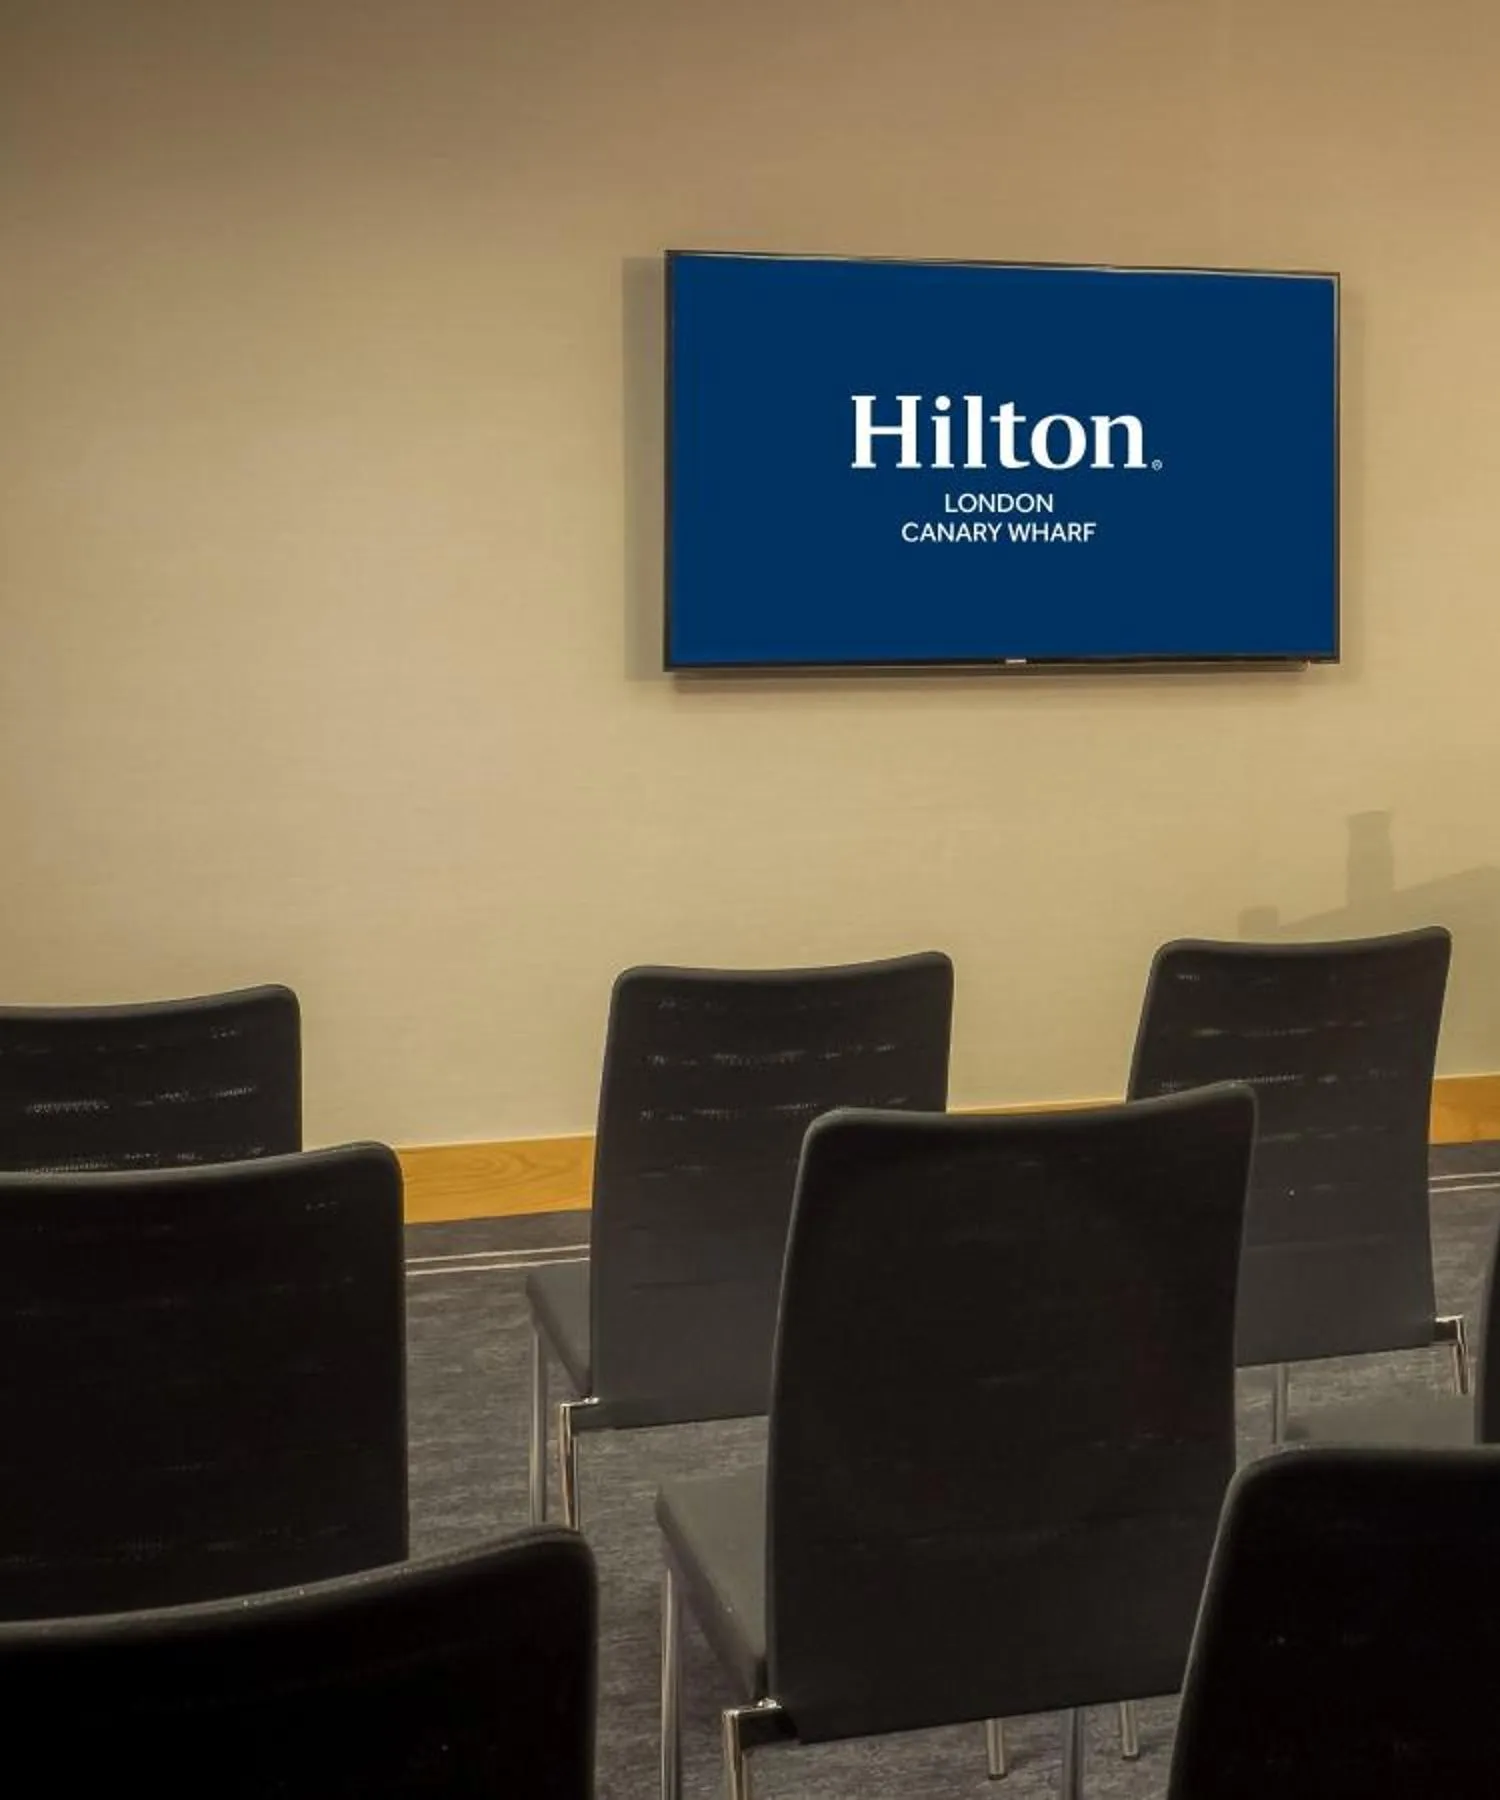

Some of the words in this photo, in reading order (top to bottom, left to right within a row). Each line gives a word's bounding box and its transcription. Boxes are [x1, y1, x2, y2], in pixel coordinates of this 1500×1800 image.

[851, 395, 1148, 470] Hilton
[945, 493, 1054, 513] LONDON
[901, 521, 1003, 543] CANARY
[1007, 521, 1097, 543] WHARF
